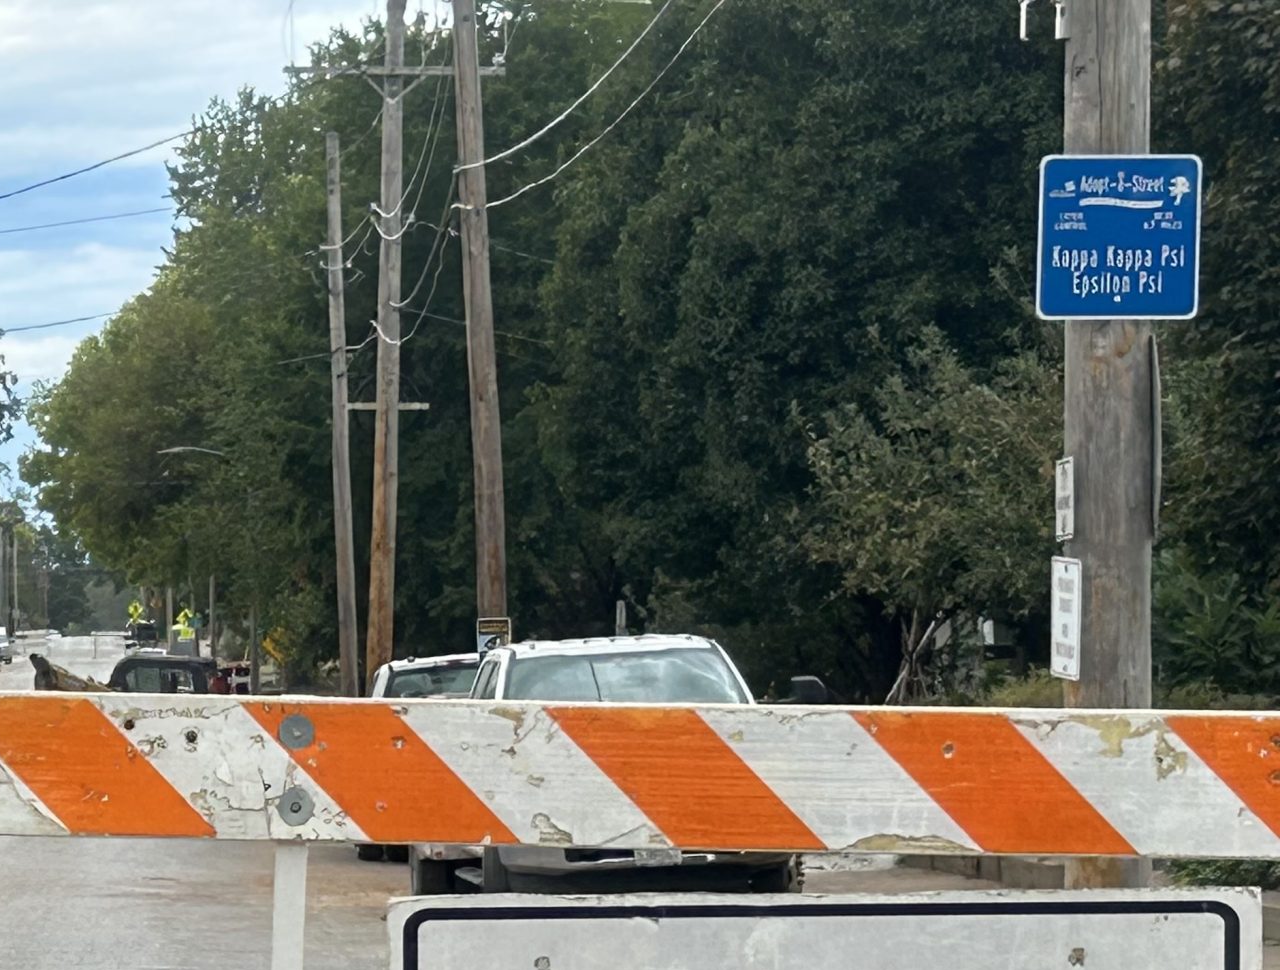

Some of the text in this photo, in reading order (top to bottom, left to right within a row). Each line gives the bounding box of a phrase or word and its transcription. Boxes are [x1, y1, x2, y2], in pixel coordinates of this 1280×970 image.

[1052, 244, 1185, 272] Kappa Kappa Psi
[1073, 271, 1163, 298] Epsilon Psi
